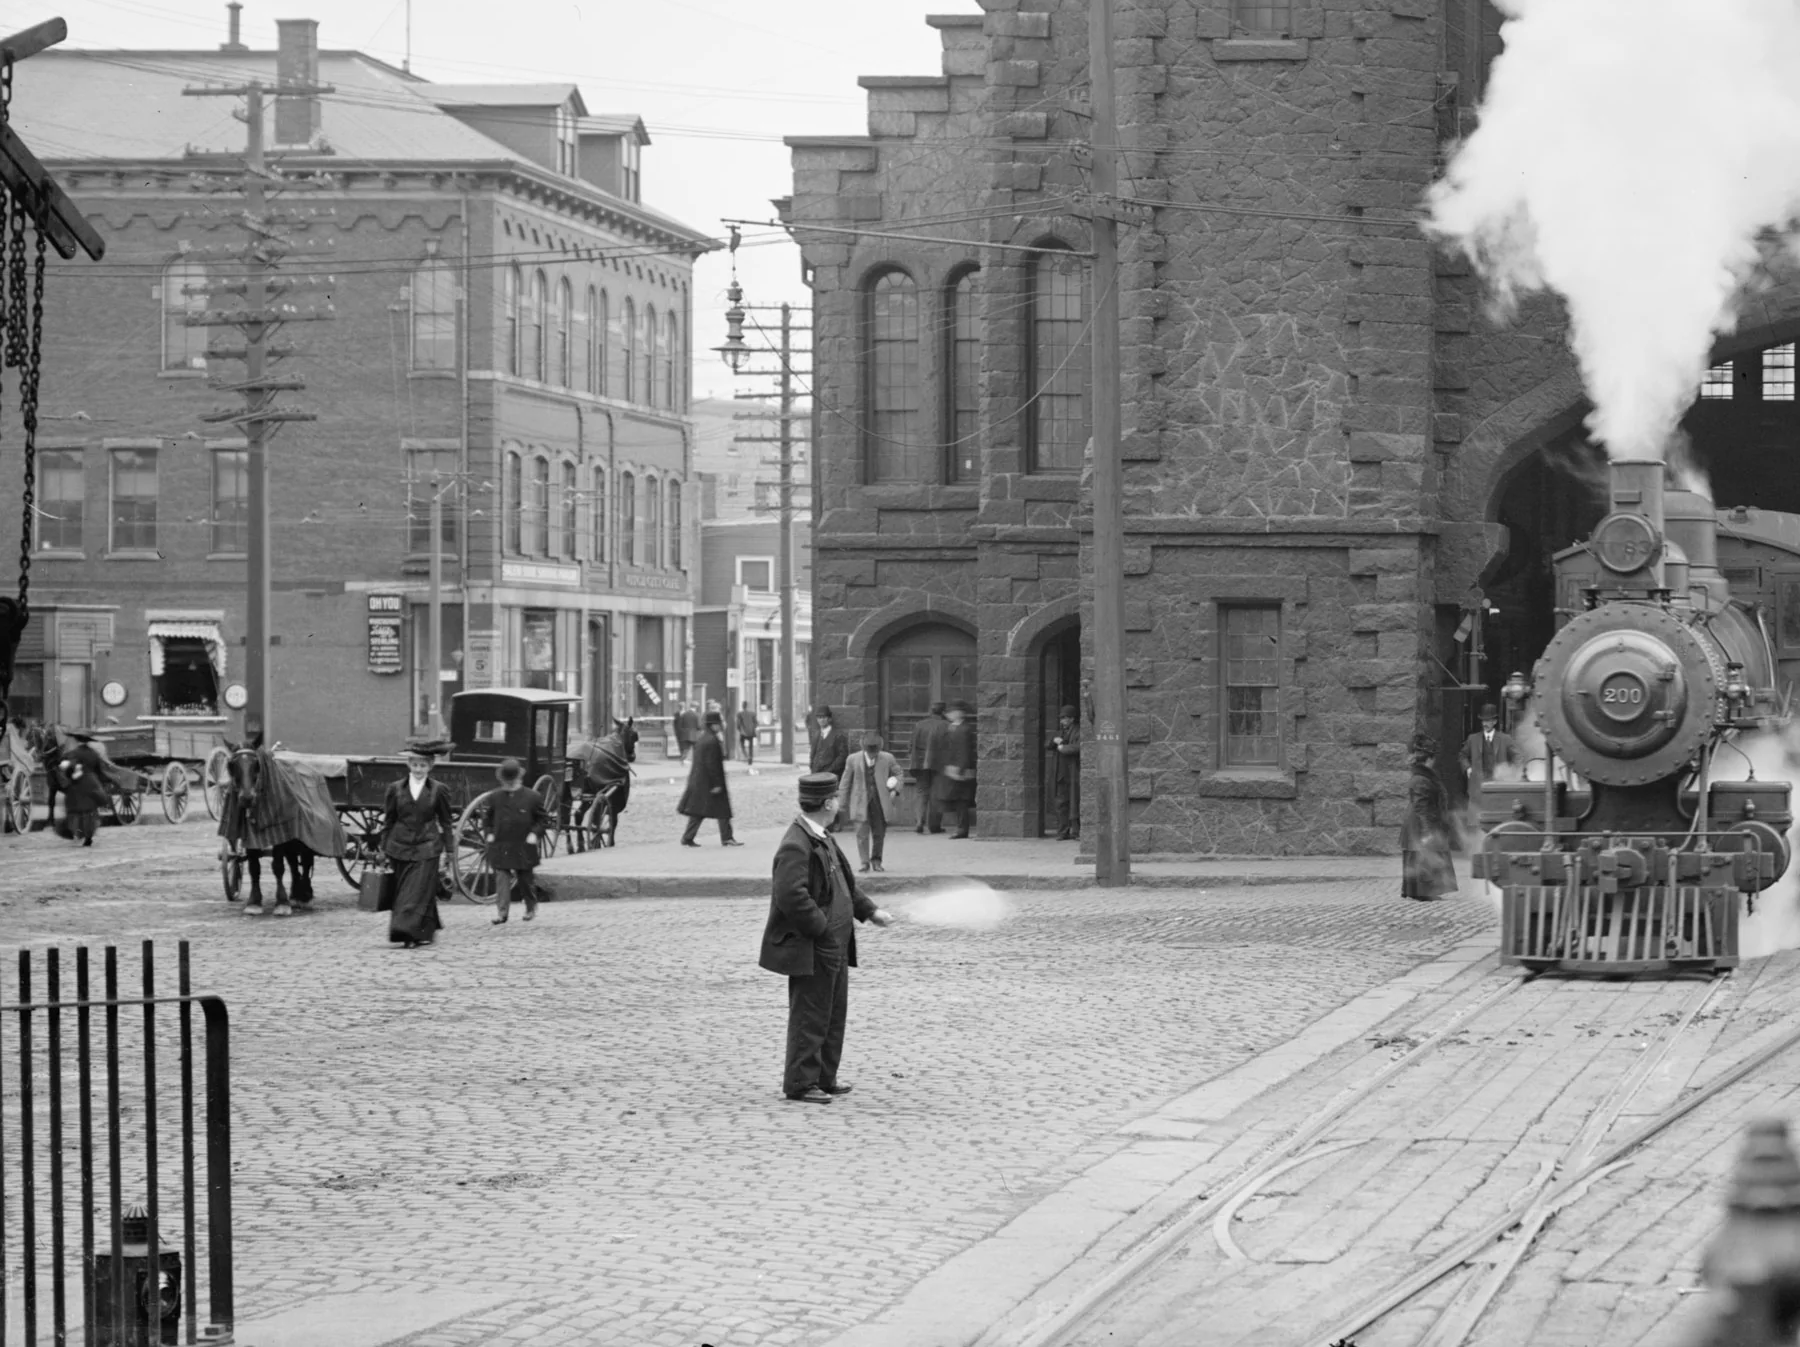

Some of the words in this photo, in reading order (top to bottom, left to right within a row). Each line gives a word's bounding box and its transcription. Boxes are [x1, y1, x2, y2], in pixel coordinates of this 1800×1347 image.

[369, 597, 382, 610] OH
[382, 597, 399, 610] YOU
[1603, 688, 1642, 704] 200
